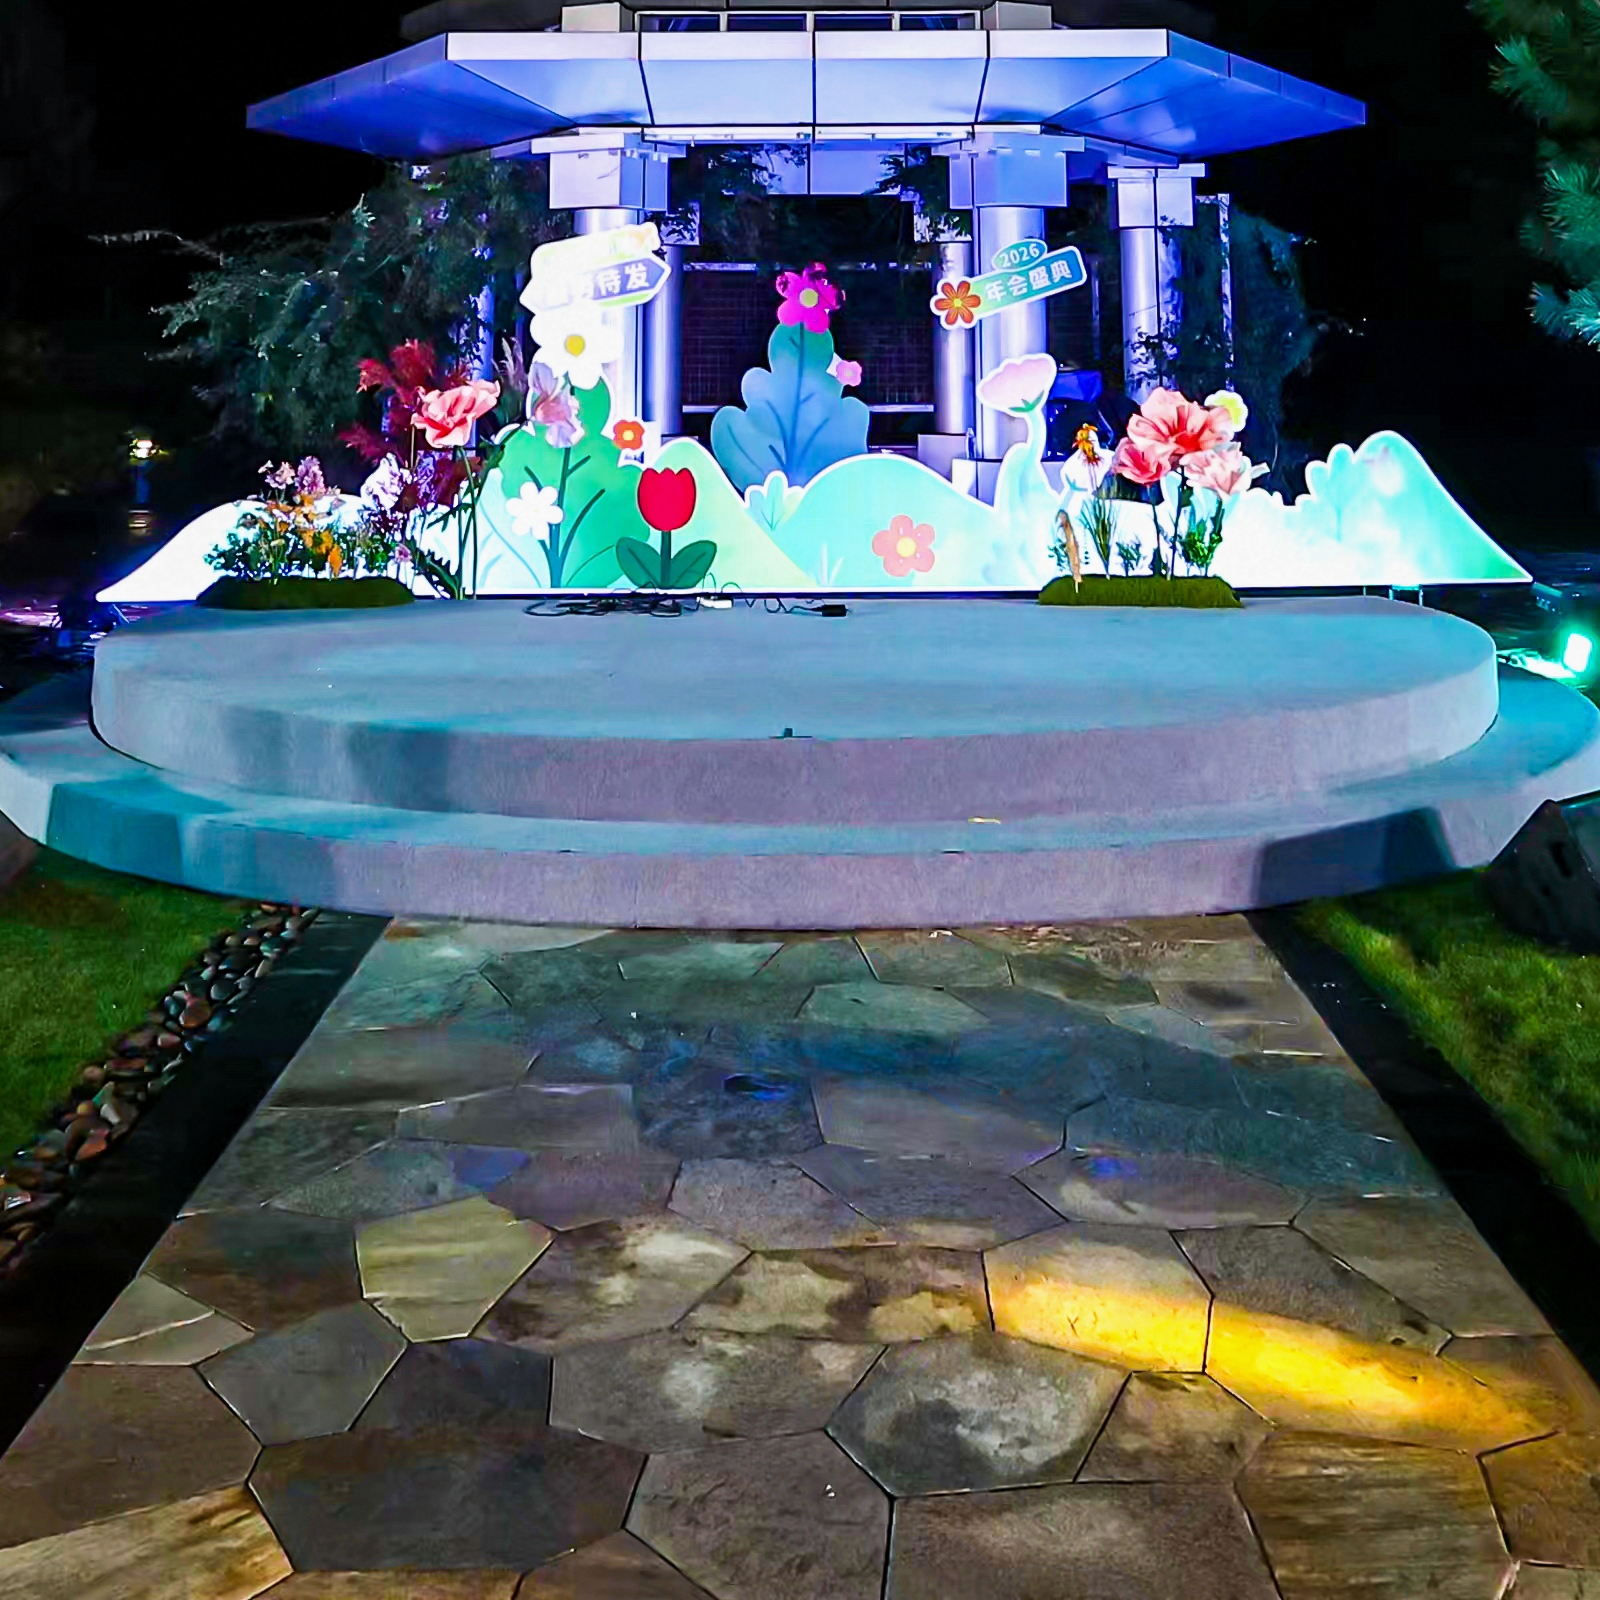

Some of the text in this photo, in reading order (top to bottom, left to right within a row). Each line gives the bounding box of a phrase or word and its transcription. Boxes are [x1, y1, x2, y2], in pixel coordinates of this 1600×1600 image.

[999, 243, 1040, 268] 2026
[984, 259, 1073, 302] 年会盛典
